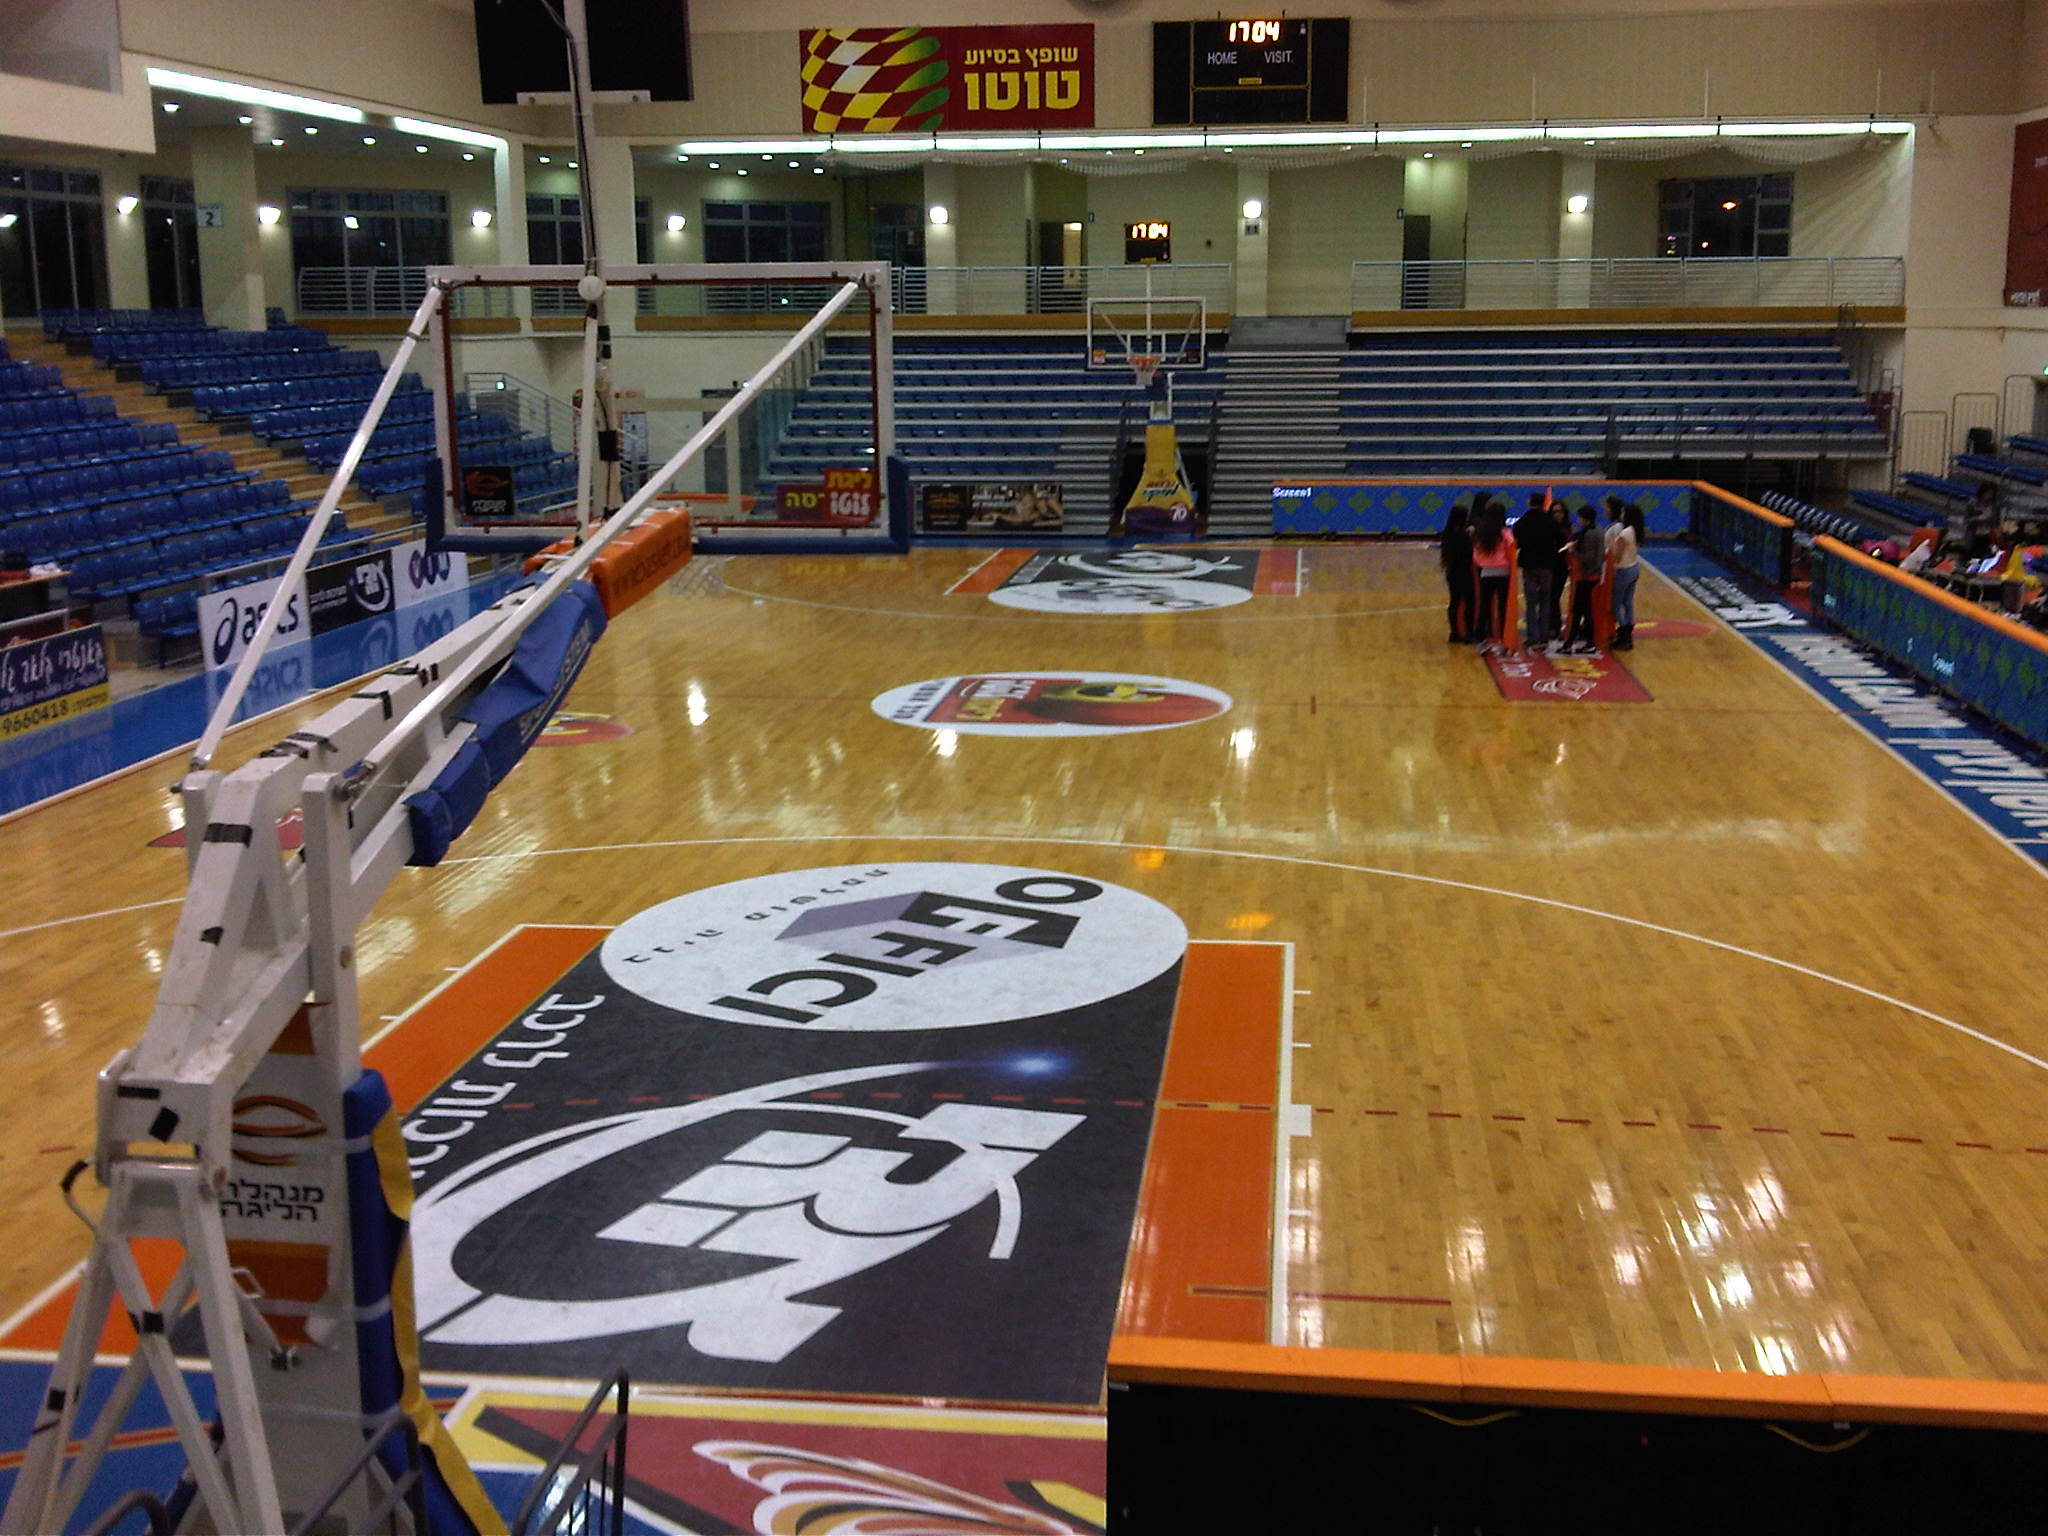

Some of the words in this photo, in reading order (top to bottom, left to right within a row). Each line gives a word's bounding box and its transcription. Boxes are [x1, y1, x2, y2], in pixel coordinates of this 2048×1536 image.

[964, 48, 1021, 65] בסיוע
[1025, 46, 1079, 69] שופץ
[1207, 51, 1238, 65] HOME
[964, 70, 1081, 111] טוטו
[242, 594, 299, 646] ascs
[221, 1199, 317, 1222] הליגה
